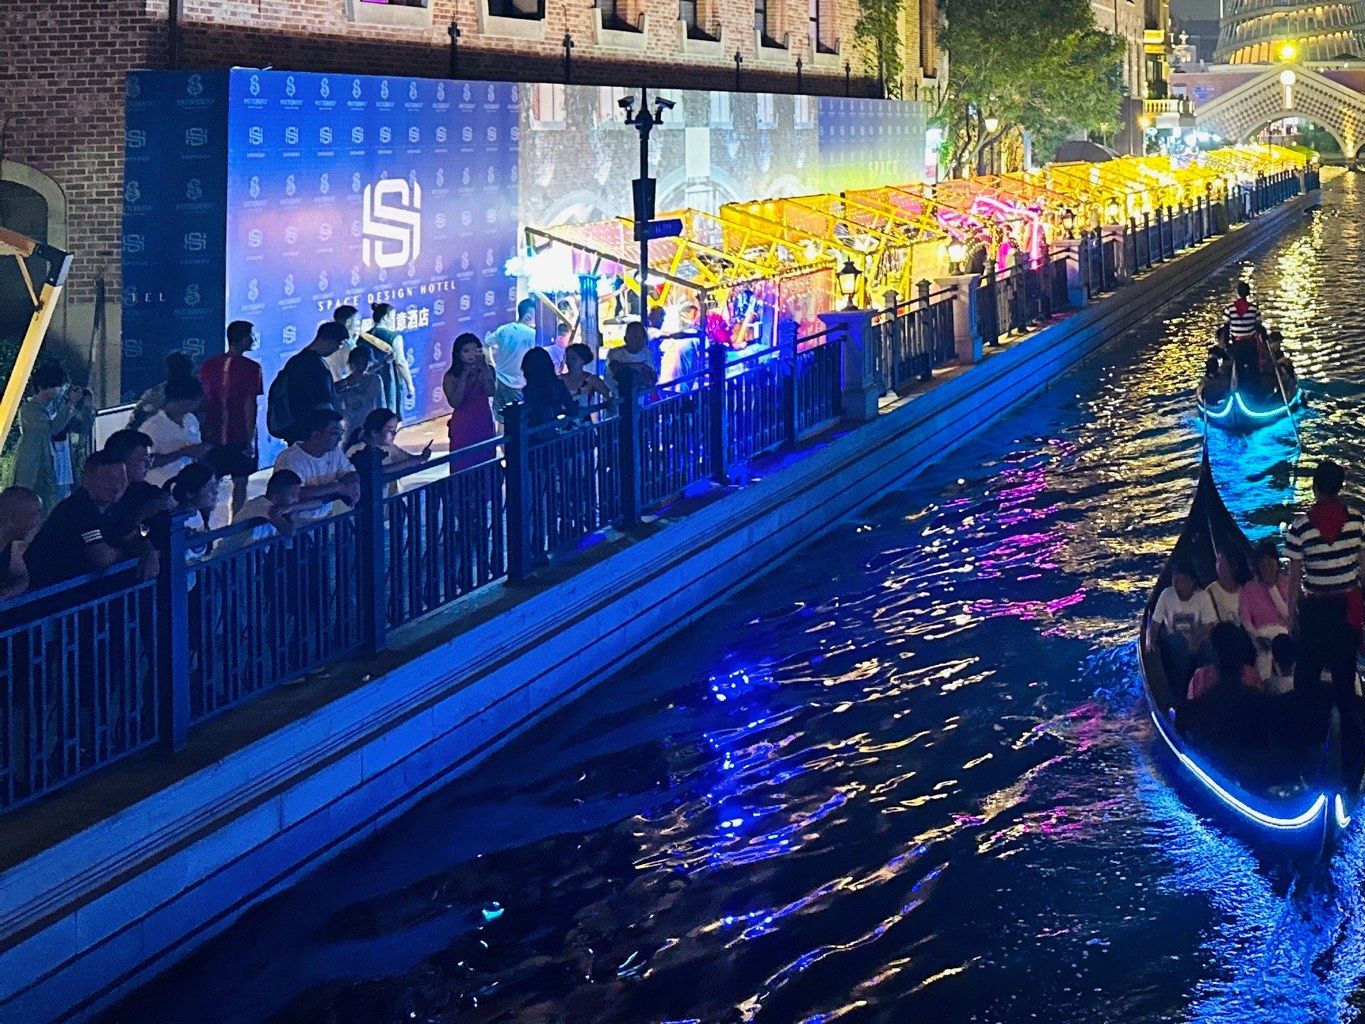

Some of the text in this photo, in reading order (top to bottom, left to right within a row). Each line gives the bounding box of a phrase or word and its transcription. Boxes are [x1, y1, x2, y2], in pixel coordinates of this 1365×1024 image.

[318, 296, 359, 312] SPACE
[367, 287, 413, 304] DESIGN
[420, 280, 456, 295] HOTEL
